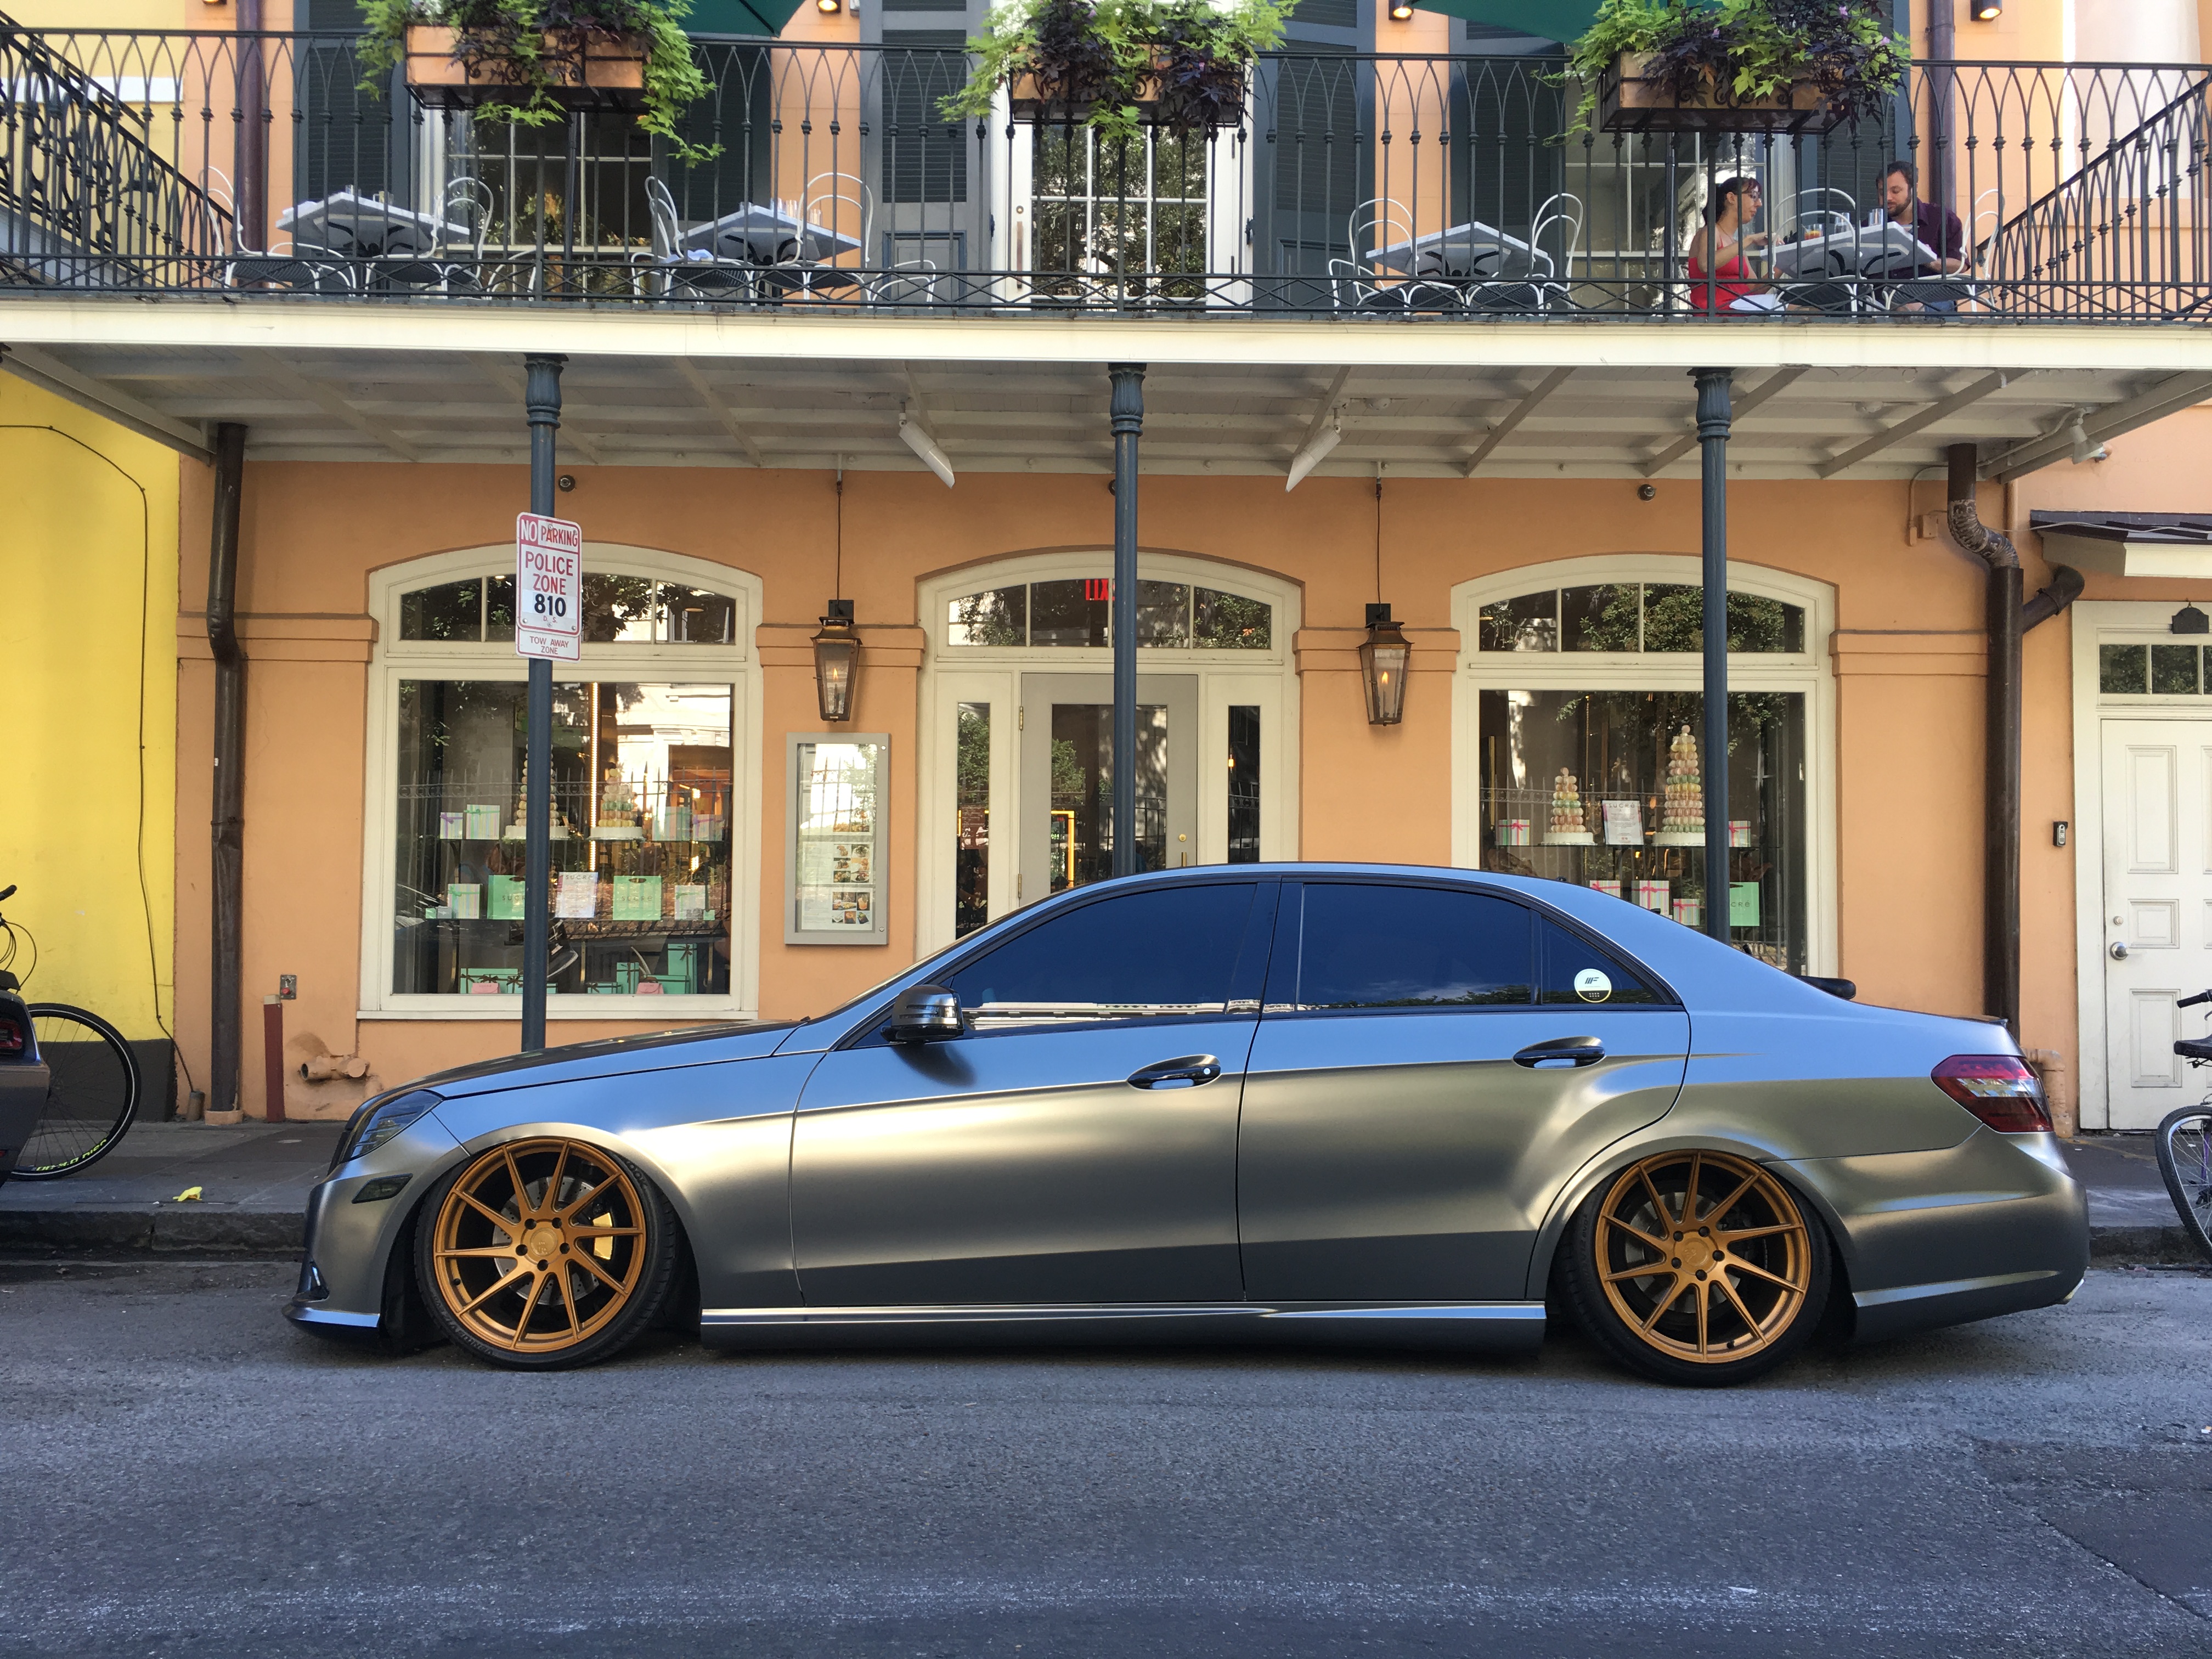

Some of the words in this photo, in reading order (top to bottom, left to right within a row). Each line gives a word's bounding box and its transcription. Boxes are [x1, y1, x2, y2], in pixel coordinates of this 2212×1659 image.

[522, 519, 537, 542] NO
[540, 527, 578, 548] PARKING
[525, 550, 574, 577] POLICE
[533, 573, 567, 596] ZONE
[534, 593, 567, 617] 810
[529, 635, 547, 646] TOW
[550, 638, 569, 648] AWAY
[540, 646, 558, 655] ZONE
